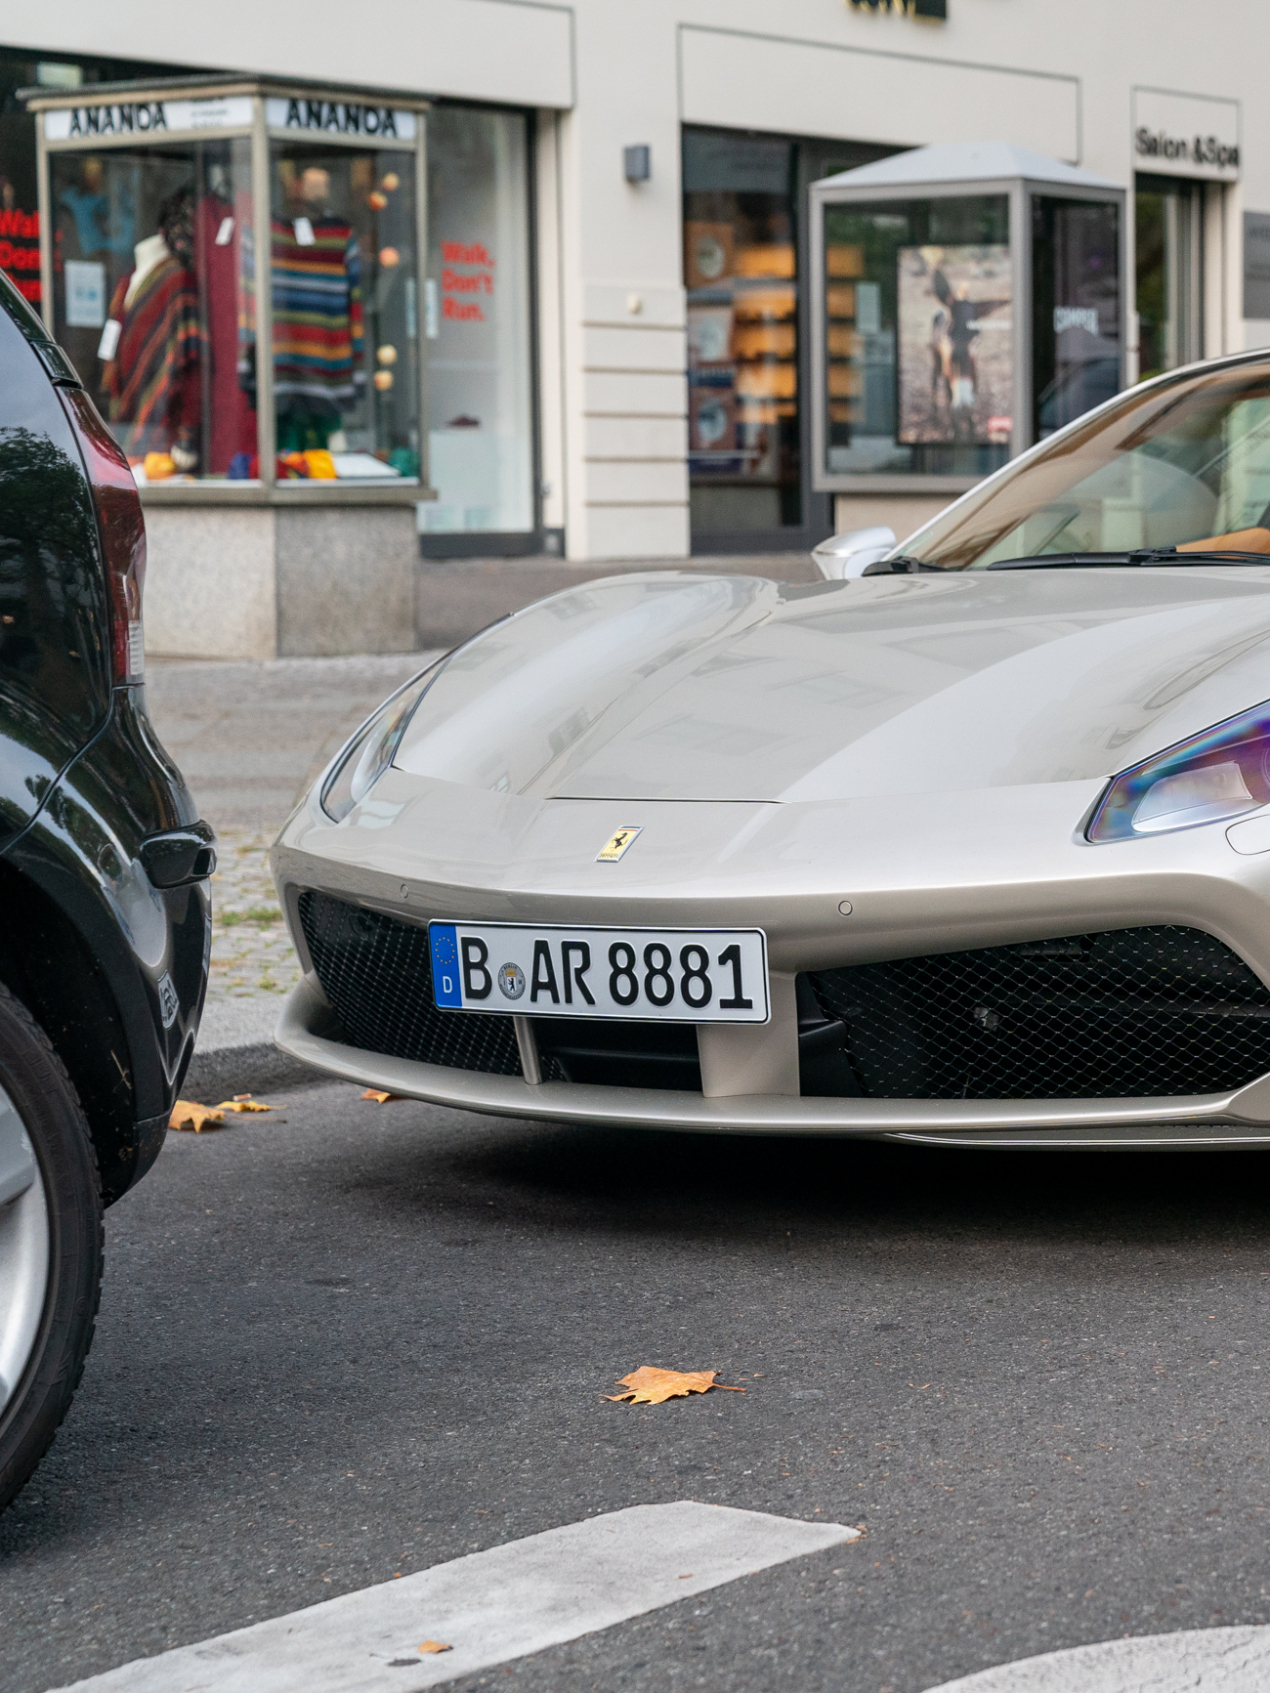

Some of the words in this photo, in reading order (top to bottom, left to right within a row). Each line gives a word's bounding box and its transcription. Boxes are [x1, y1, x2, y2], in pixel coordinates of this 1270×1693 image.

[70, 102, 168, 138] ANANDA
[285, 98, 398, 139] ANANDA
[1136, 126, 1188, 160] Salon
[441, 268, 493, 295] Don't
[442, 296, 486, 321] Run.
[459, 936, 492, 1000] B
[530, 939, 596, 1005] AR
[608, 941, 753, 1009] 8881
